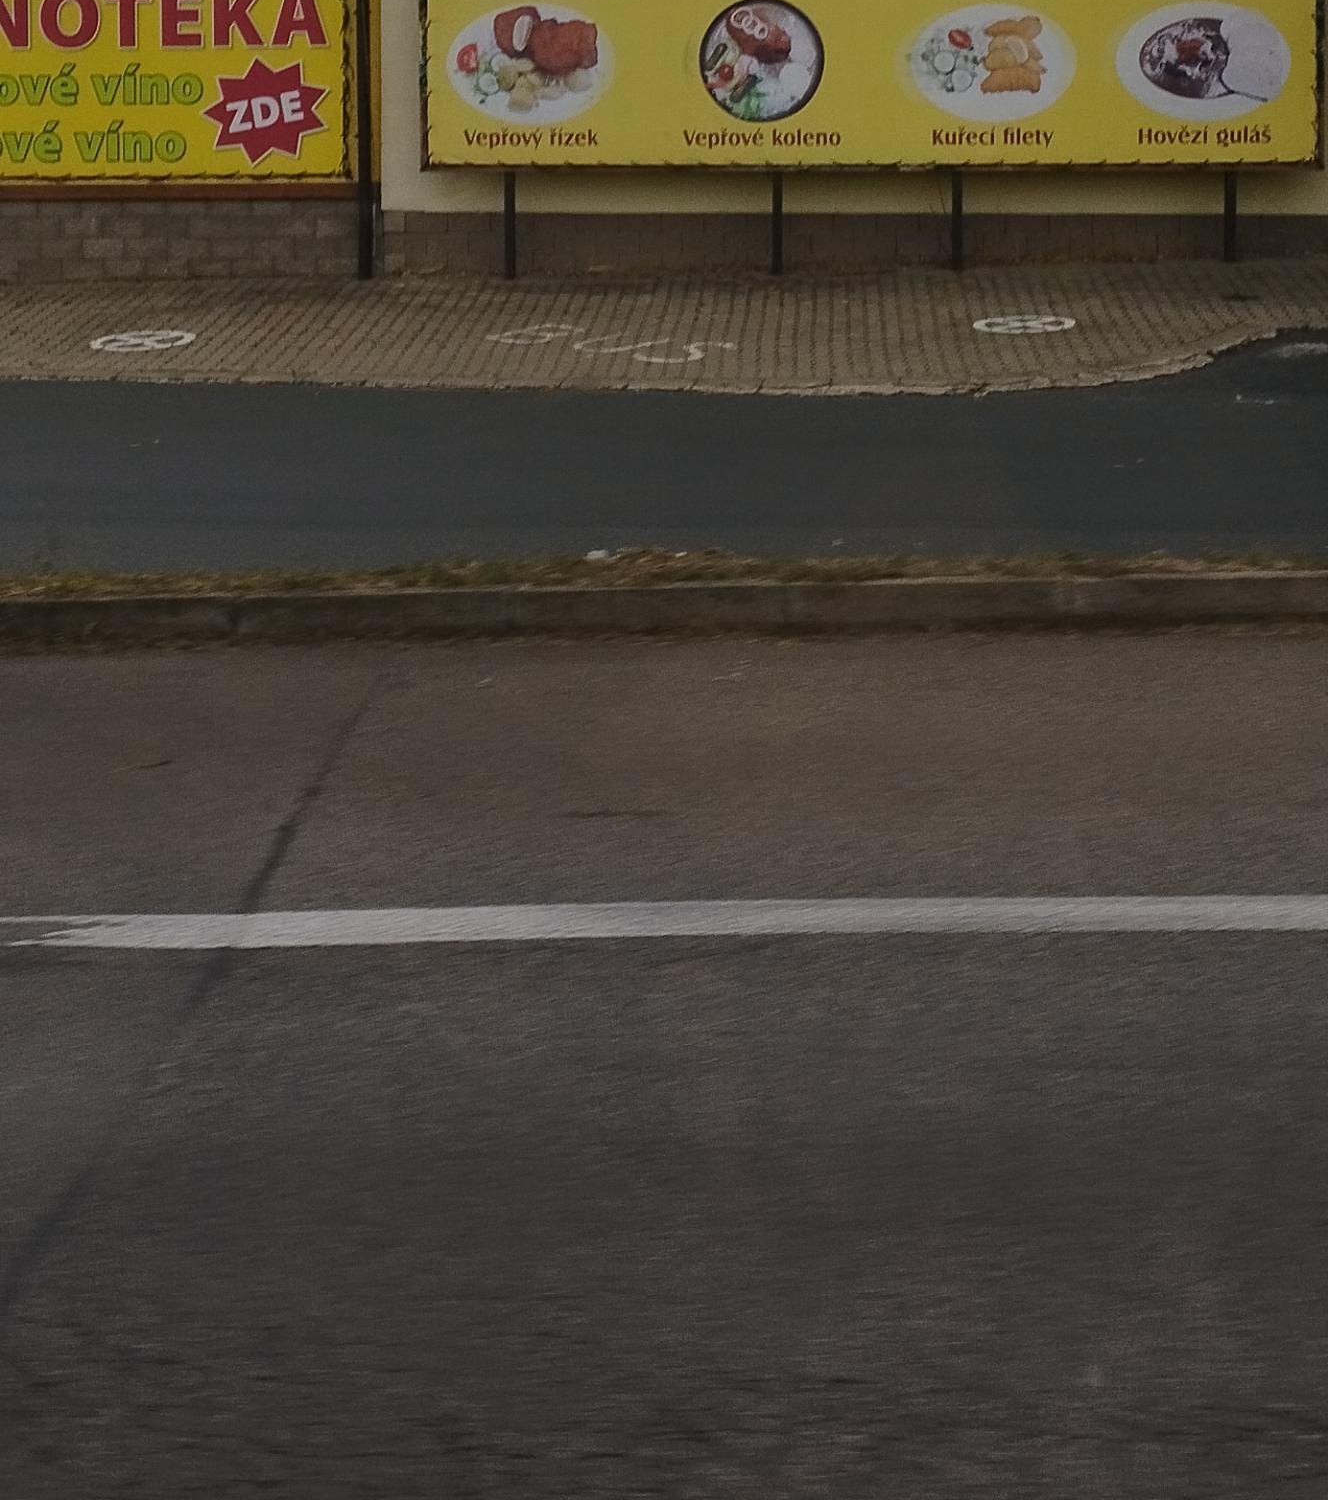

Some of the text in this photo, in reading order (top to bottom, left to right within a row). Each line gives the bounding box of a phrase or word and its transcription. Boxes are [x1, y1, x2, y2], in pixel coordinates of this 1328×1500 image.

[90, 61, 206, 106] víno
[225, 89, 306, 134] ZDE
[74, 119, 188, 163] víno
[463, 128, 599, 150] Vepřový řízek
[682, 128, 842, 150] Vepřové koleno
[931, 127, 1055, 148] Kuřecí filety
[1137, 125, 1273, 148] Hovězí guláš
[486, 323, 736, 364] BUS
